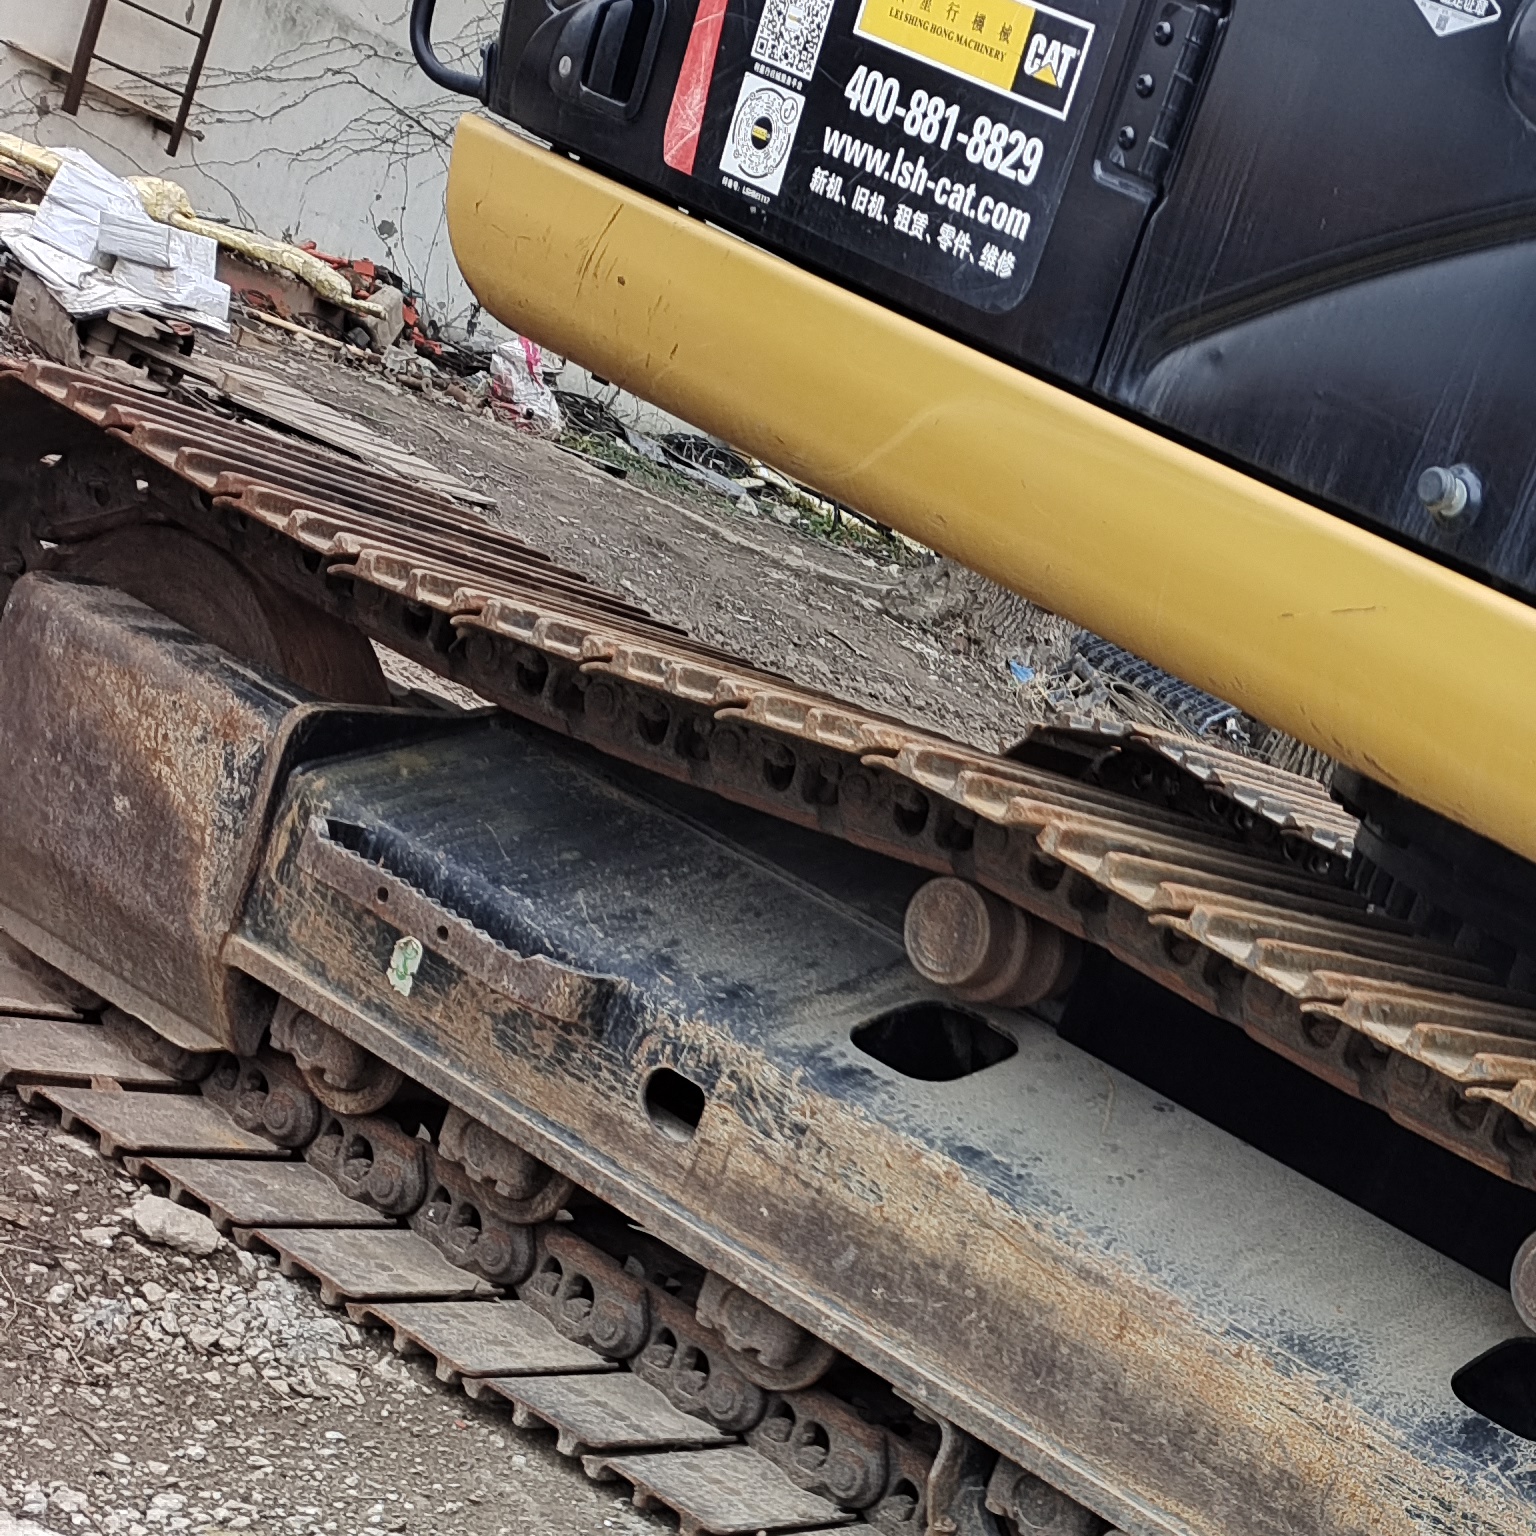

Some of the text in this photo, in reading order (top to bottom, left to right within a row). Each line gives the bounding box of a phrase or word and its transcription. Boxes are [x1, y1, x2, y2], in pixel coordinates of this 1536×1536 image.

[889, 6, 1007, 62] LEI SHING HONG MACHINERY
[1023, 32, 1079, 89] CAT
[844, 64, 1043, 186] 400-881-8829
[822, 126, 1031, 242] www.lsh-cat.com
